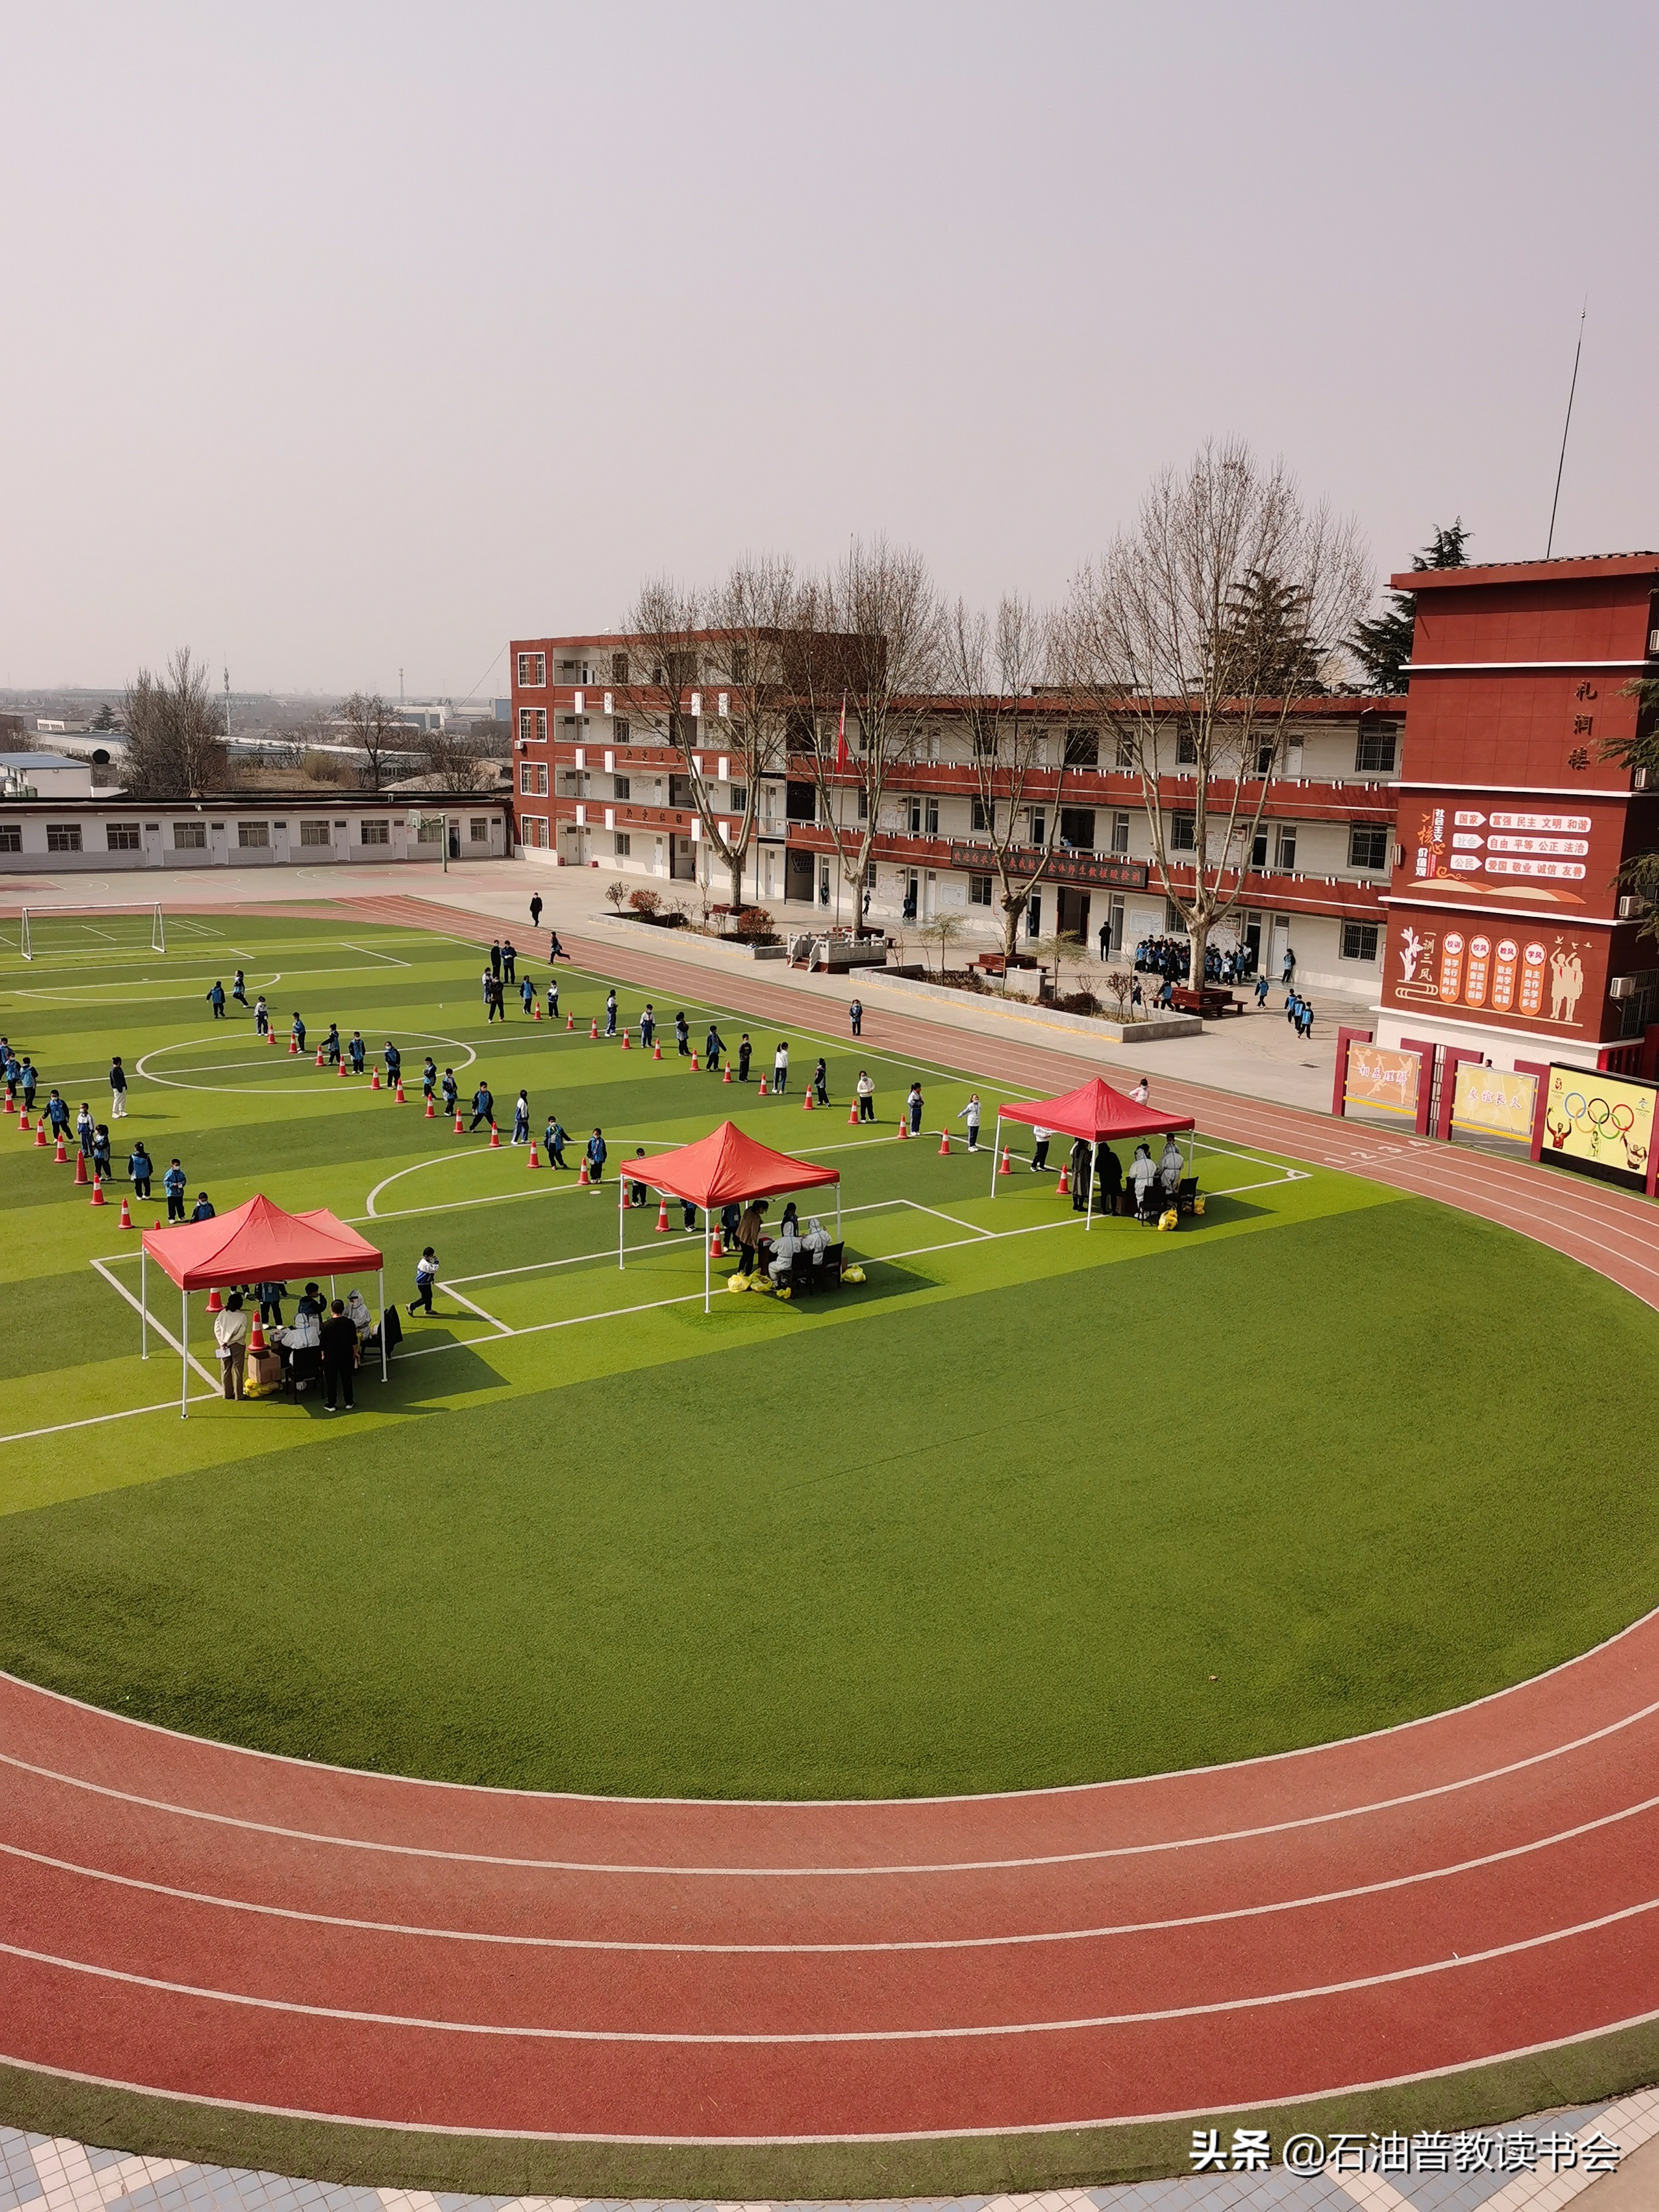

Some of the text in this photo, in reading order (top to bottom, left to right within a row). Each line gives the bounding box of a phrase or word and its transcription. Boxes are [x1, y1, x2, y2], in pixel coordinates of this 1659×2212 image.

[1568, 680, 1598, 771] 礼润楼
[1459, 814, 1478, 825] 国家
[1492, 815, 1588, 831] 富强 民主 文明 和谐
[1433, 808, 1446, 843] 社会主义
[1417, 825, 1446, 856] 核心
[1457, 836, 1476, 847] 社会
[1490, 838, 1584, 854] 自由 平等 公正 法治
[1415, 848, 1428, 877] 价值观
[1455, 858, 1473, 868] 公民
[1488, 860, 1583, 877] 爱国 敬业 诚信 友善
[1418, 931, 1437, 982] 一训三风
[1500, 947, 1514, 956] 教风
[1527, 951, 1543, 959] 学风
[1470, 962, 1485, 971] 团结
[1497, 965, 1513, 975] 敬业
[1469, 971, 1485, 981] 奋进
[1524, 969, 1541, 979] 自主
[1496, 975, 1512, 985] 尚学
[1524, 979, 1540, 989] 合作
[1469, 981, 1483, 990] 求实
[1495, 985, 1510, 995] 严谨
[1442, 986, 1456, 996] 树人
[1467, 990, 1483, 1000] 创新
[1523, 989, 1538, 998] 乐学
[1494, 994, 1510, 1004] 博爱
[1521, 999, 1538, 1008] 多思
[1359, 1065, 1408, 1087] 相互理解
[1467, 1087, 1523, 1110] 友谊长久
